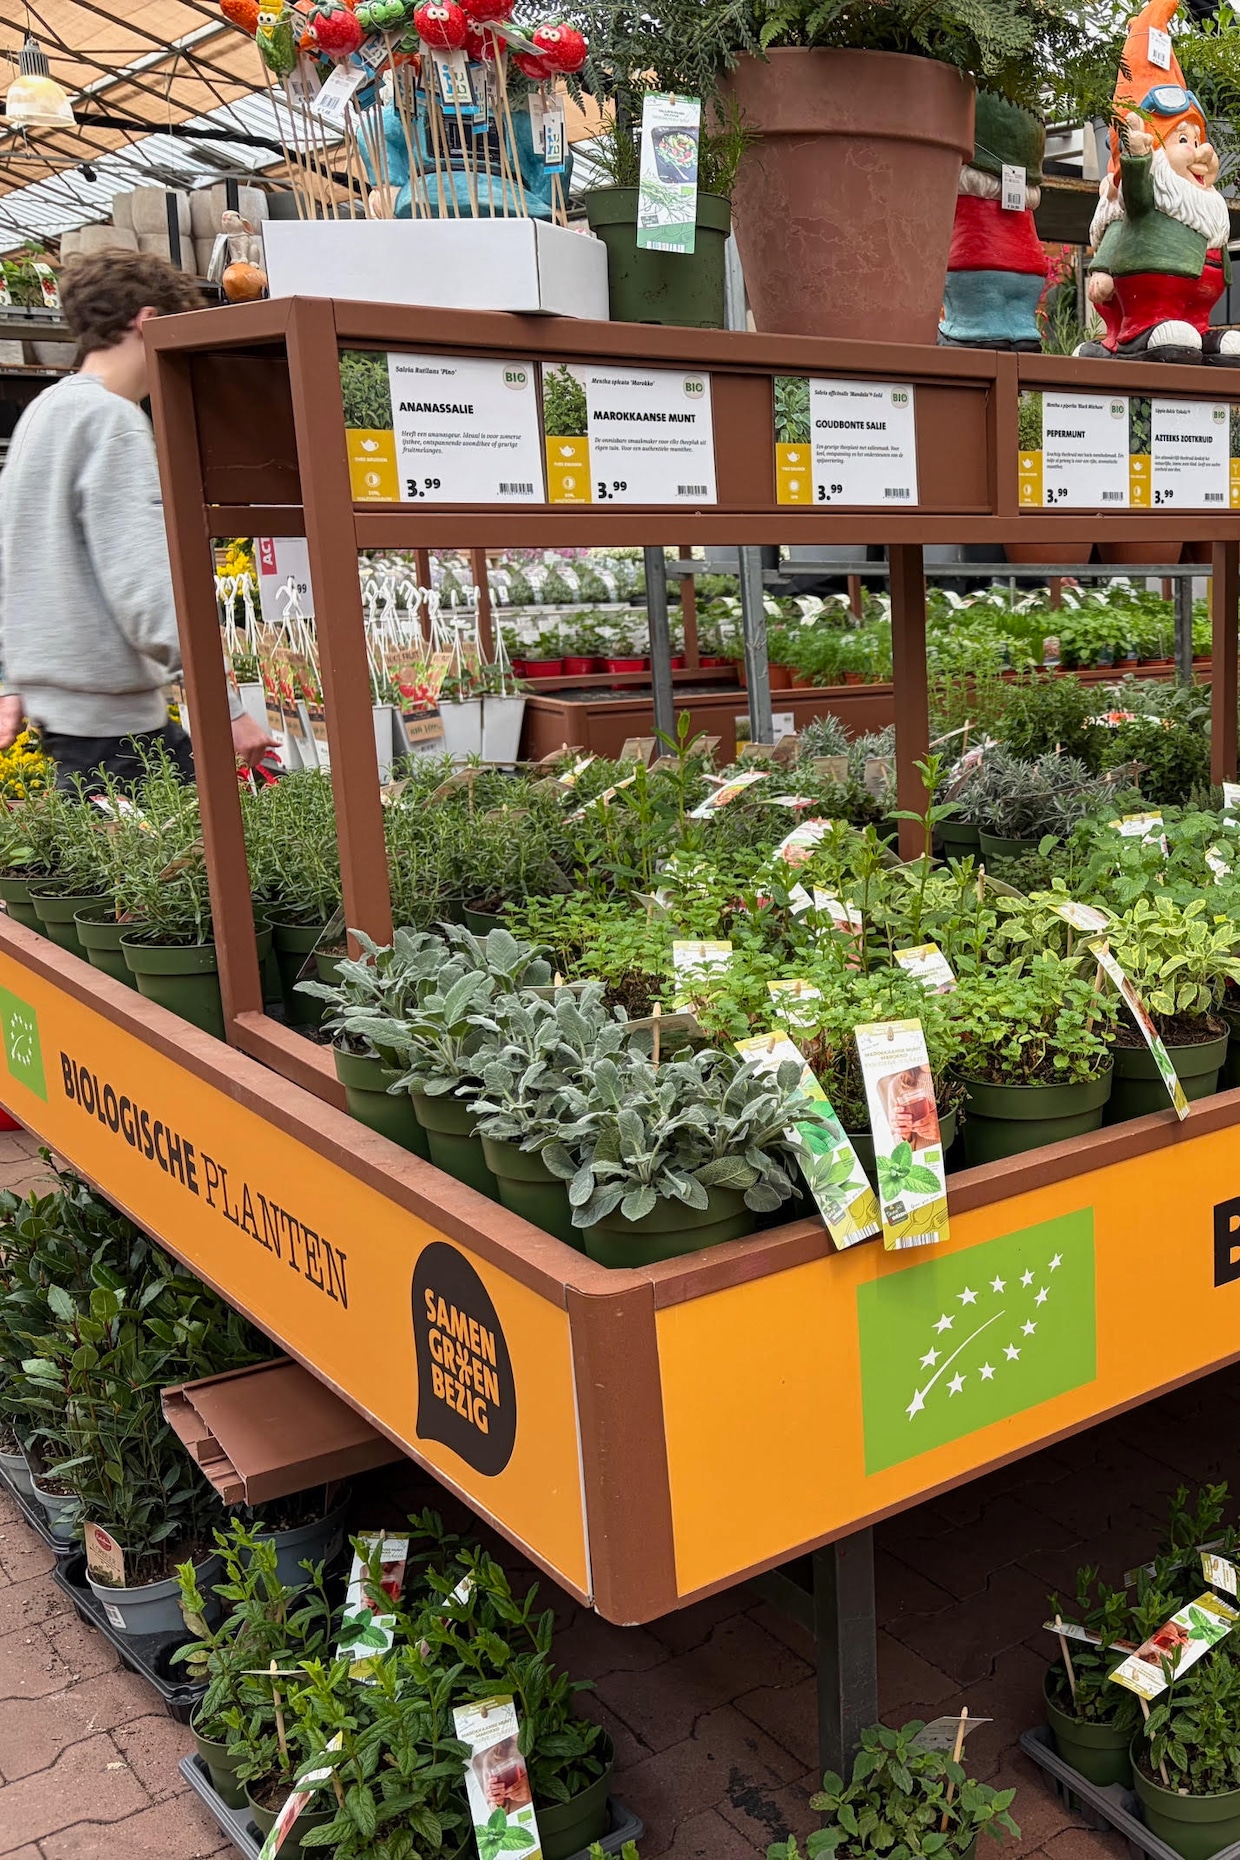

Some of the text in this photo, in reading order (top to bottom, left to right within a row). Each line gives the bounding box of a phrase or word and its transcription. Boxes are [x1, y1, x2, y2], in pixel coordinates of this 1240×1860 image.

[505, 372, 526, 383] BIO
[686, 382, 703, 392] BIO
[892, 393, 908, 402] BIO
[400, 402, 474, 414] ANANASSALIE
[1112, 406, 1124, 414] BIO
[594, 411, 696, 423] MAROKKAANSE MUNT
[1214, 411, 1226, 419] BIO
[816, 420, 887, 430] GOUDBONTE SALIE
[1046, 430, 1086, 438] PEPERMUNT
[1154, 434, 1213, 444] AZTEEKS ZOETKRUID
[406, 478, 441, 498] 3.99
[598, 481, 628, 499] 3.99
[818, 484, 843, 500] 3.99
[1047, 488, 1068, 503] 3.99
[1154, 490, 1174, 504] 3.99
[59, 1050, 349, 1310] BIOLOGISCHE PLANTEN
[424, 1287, 497, 1368] SAMEN
[430, 1362, 490, 1435] BEZIG
